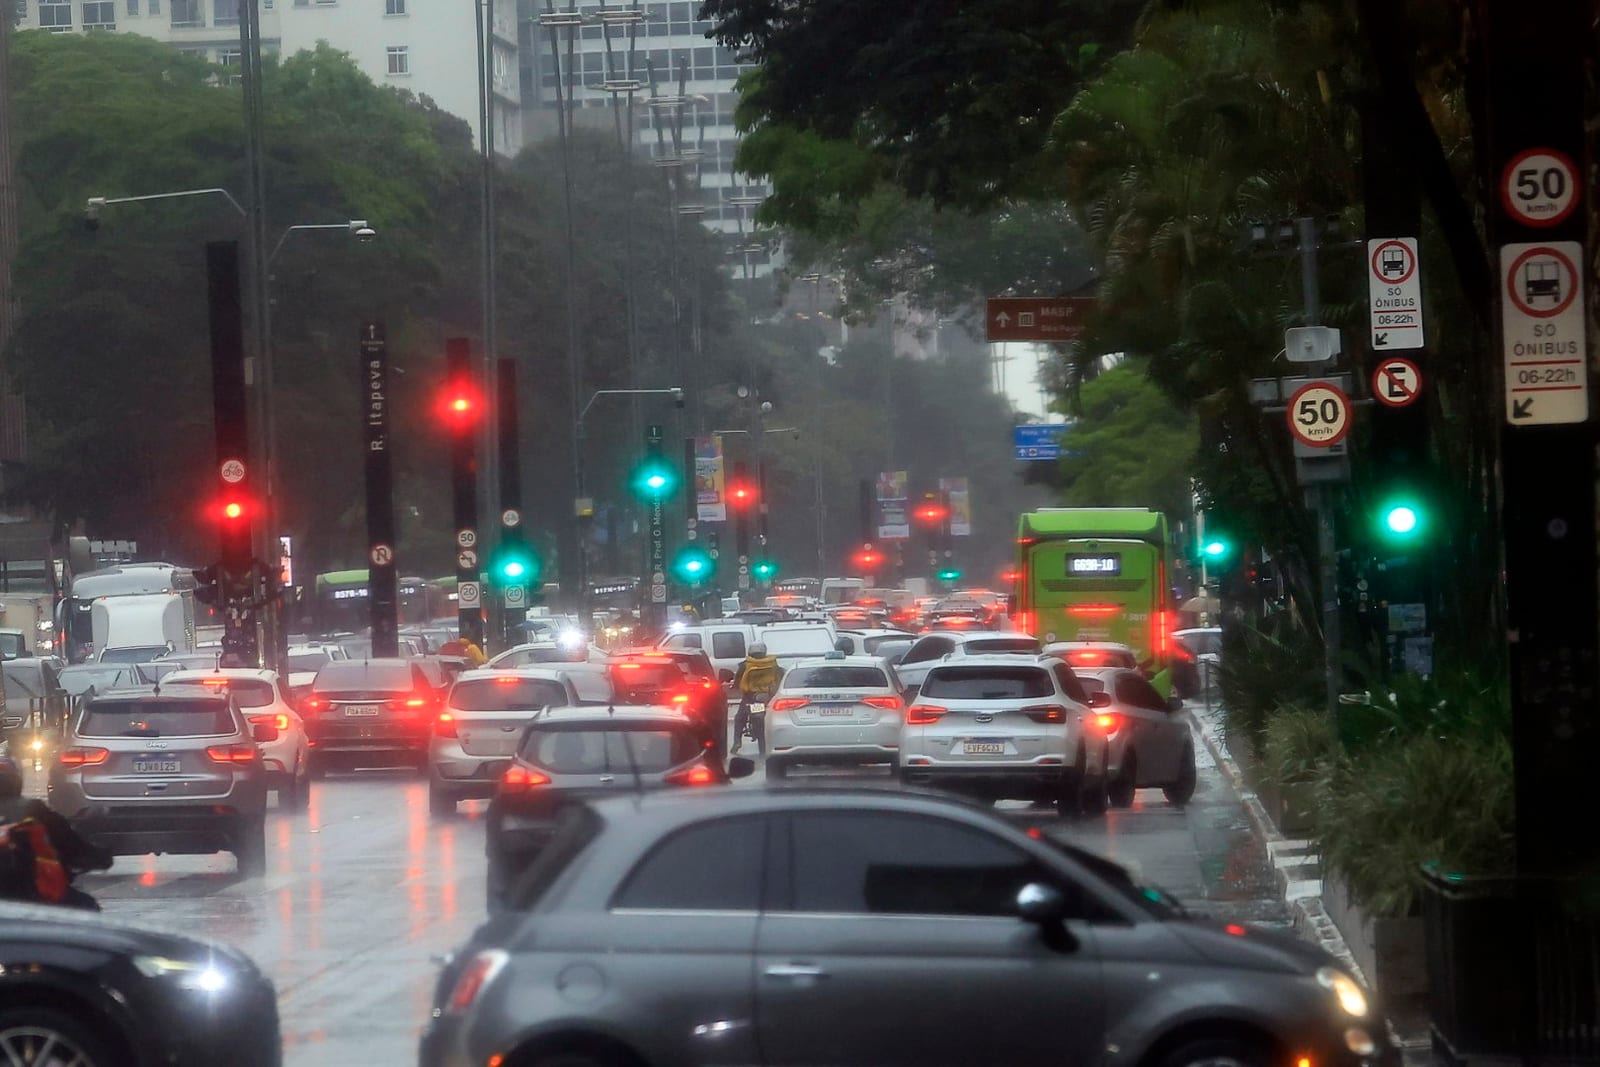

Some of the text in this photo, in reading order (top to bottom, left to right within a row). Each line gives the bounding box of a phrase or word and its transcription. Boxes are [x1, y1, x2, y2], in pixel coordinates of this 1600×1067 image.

[1517, 168, 1565, 200] 50
[1378, 314, 1414, 325] 06-22h
[1518, 368, 1576, 384] 06-22h
[369, 360, 384, 425] Itapeva
[1298, 399, 1339, 426] 50
[1308, 427, 1333, 436] km/h
[371, 435, 383, 451] R.
[460, 533, 474, 542] 50
[463, 588, 475, 596] 20
[509, 589, 520, 597] 20
